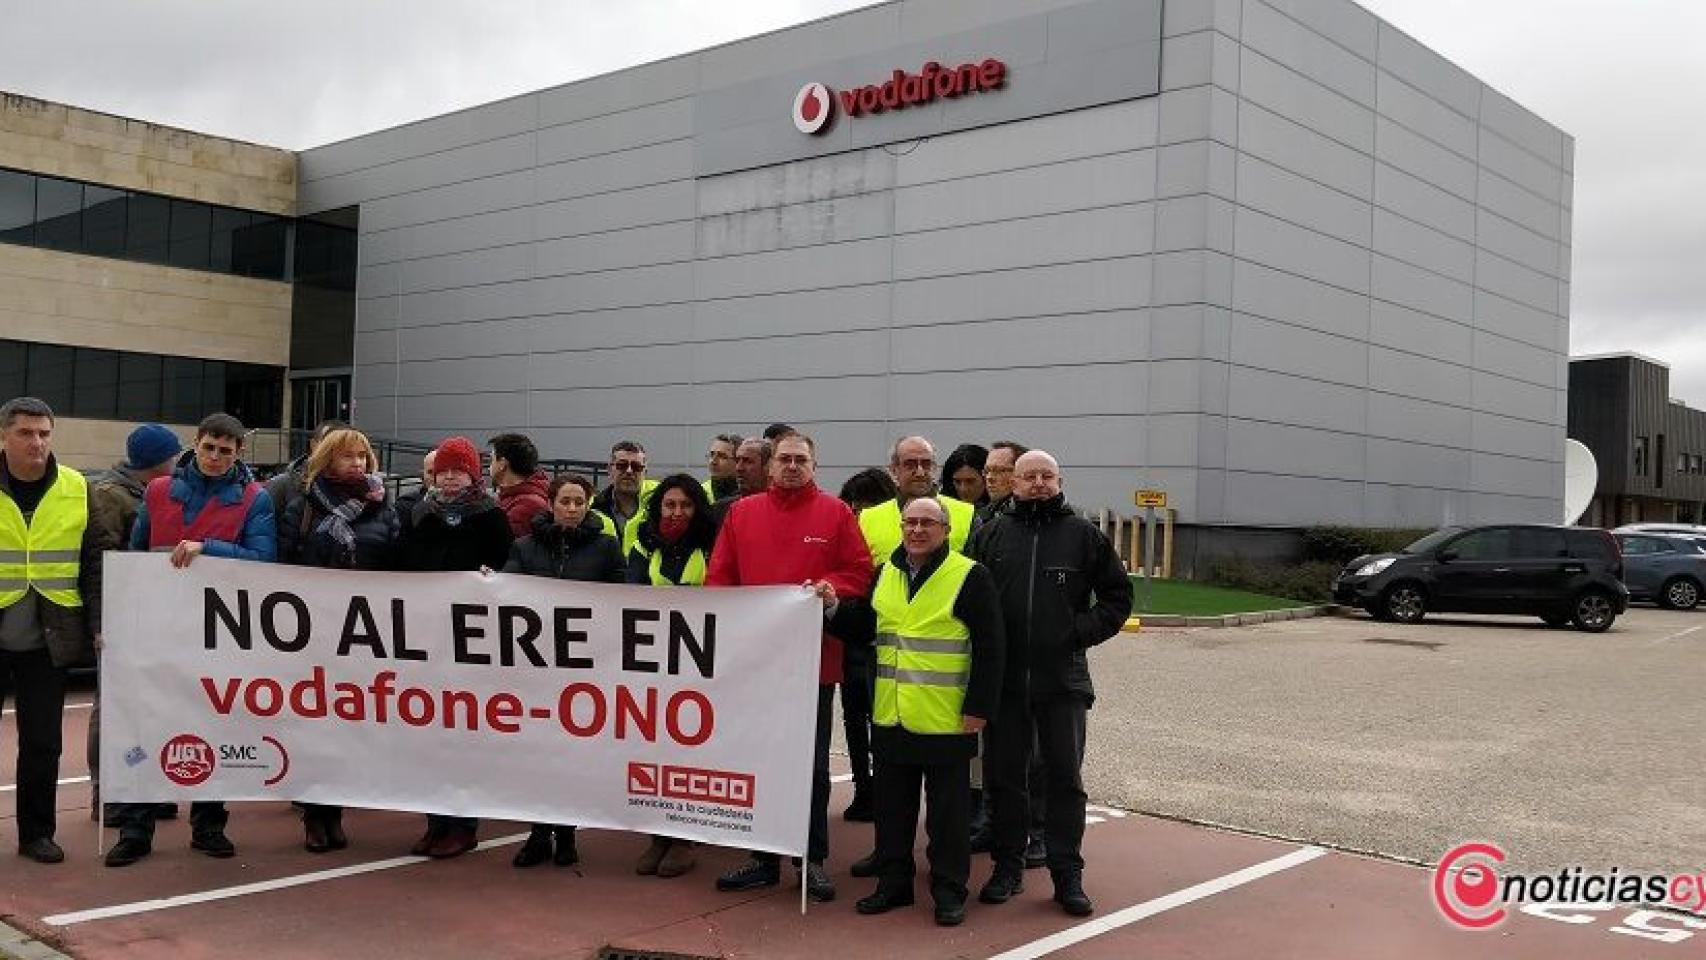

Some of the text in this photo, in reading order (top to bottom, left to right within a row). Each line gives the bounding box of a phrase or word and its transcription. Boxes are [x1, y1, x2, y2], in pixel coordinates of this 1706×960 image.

[840, 58, 1005, 117] vodafone
[203, 587, 717, 679] NO AL ERE EN
[200, 665, 715, 747] vodafone-ONO
[167, 744, 208, 764] UGT
[219, 744, 257, 760] SMC
[668, 771, 748, 802] CCOO
